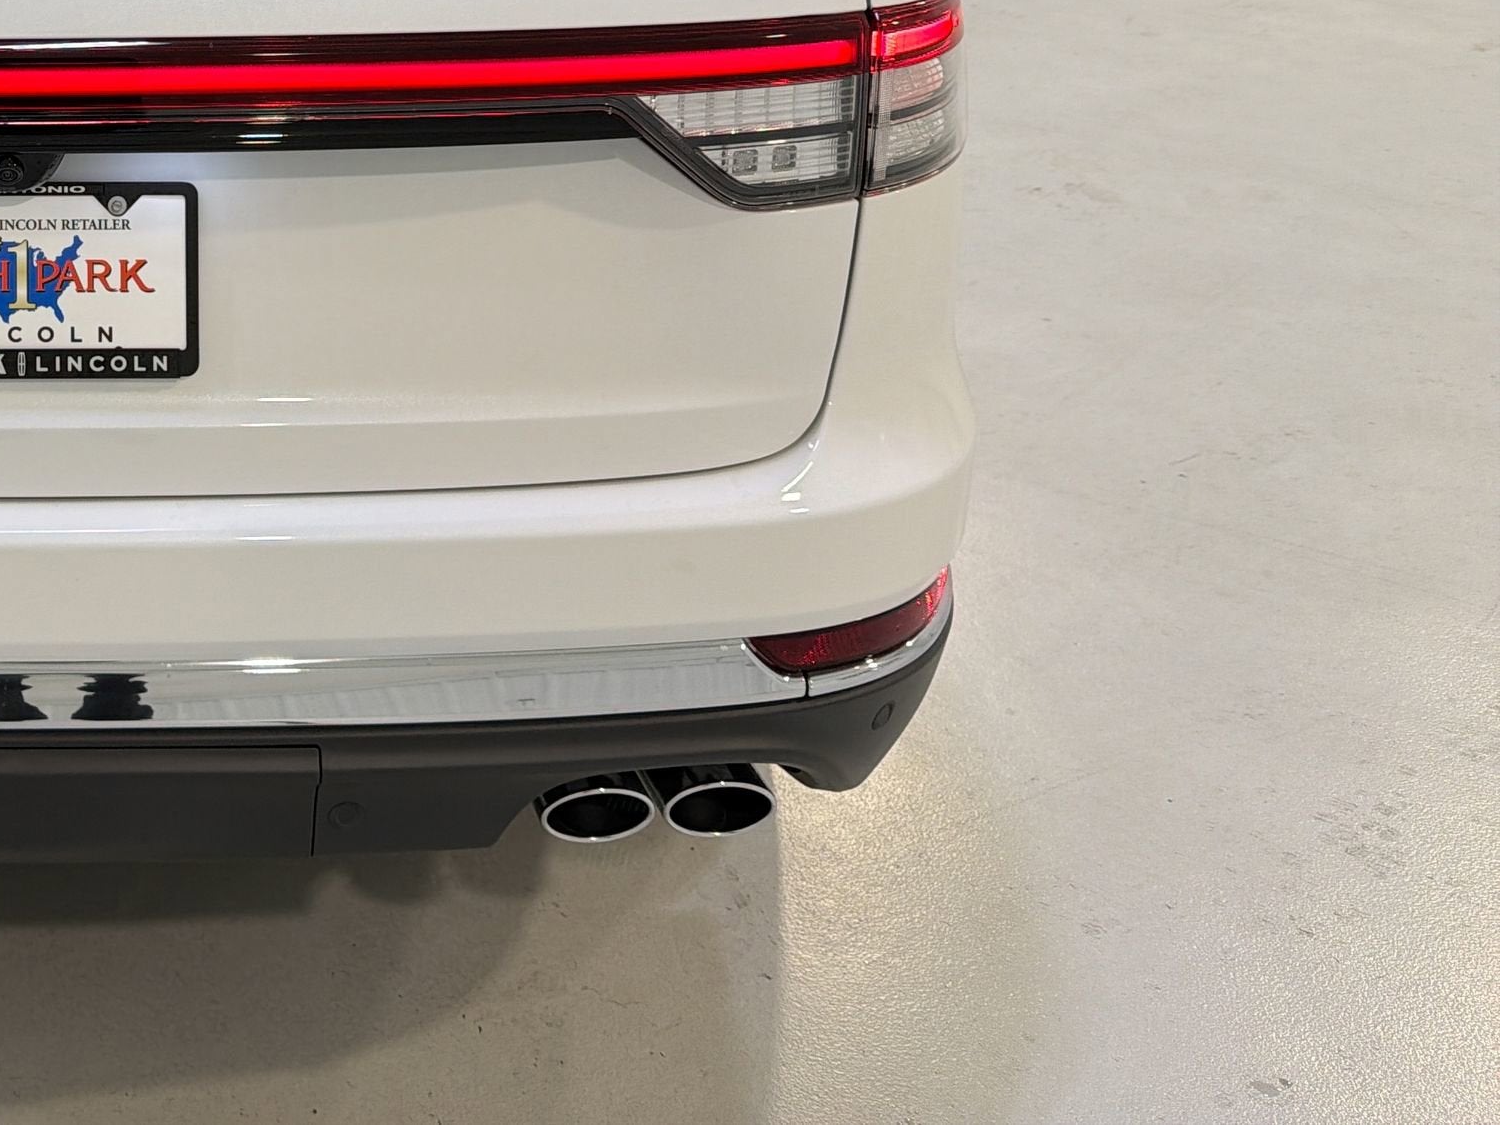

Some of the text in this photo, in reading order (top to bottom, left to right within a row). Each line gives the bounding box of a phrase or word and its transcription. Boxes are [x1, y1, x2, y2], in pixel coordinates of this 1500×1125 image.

[61, 219, 131, 231] RETAILER
[35, 258, 156, 293] PARK
[36, 356, 169, 373] LINCOLN
